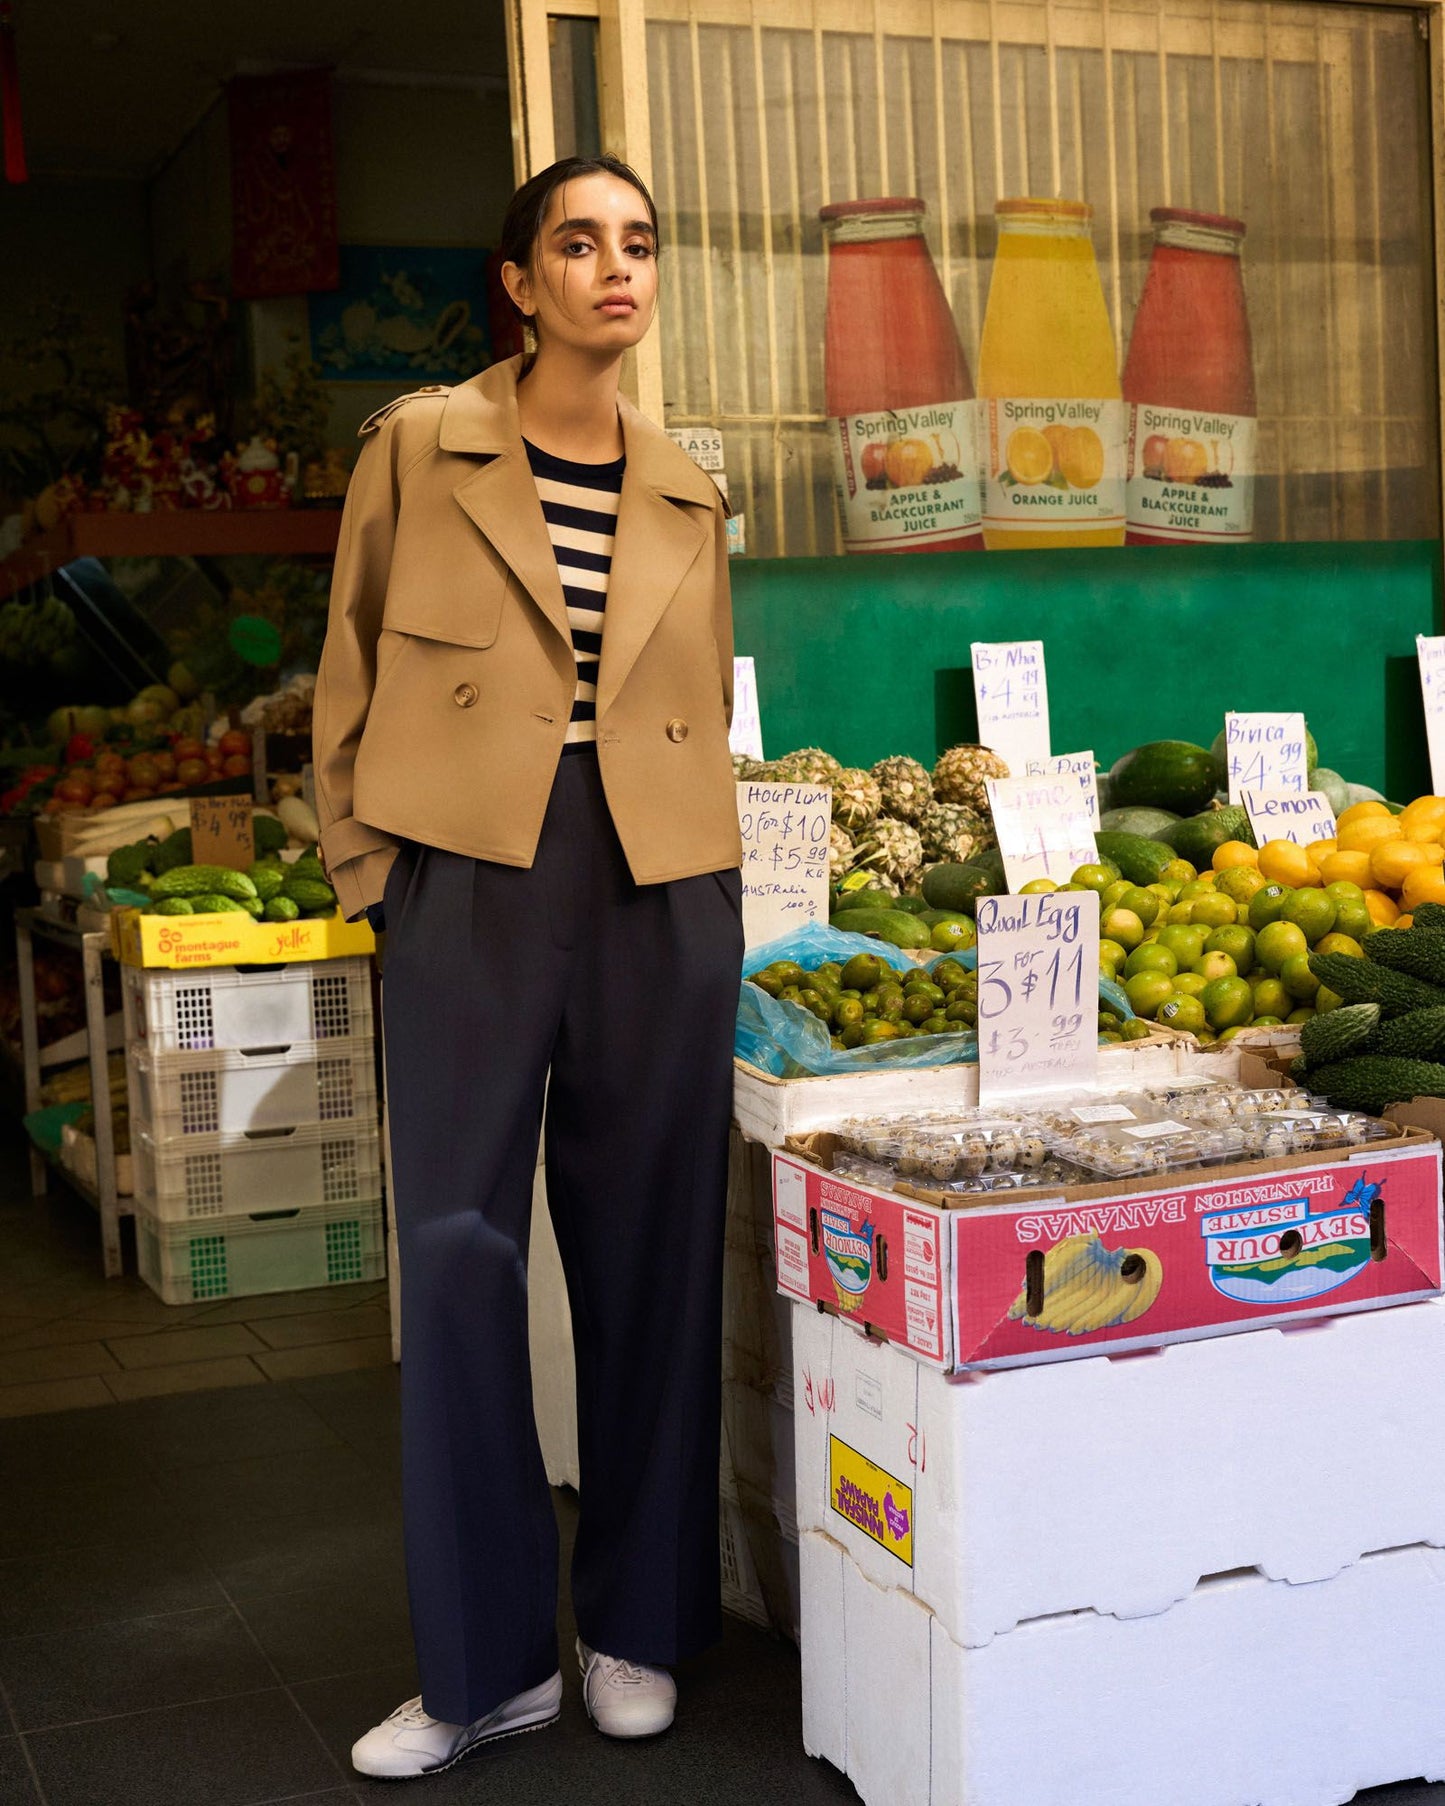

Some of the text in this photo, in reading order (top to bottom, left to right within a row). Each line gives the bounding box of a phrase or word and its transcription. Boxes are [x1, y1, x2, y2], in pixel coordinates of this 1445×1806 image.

[1004, 402, 1101, 422] Spring Valley
[855, 410, 955, 438] Spring Valley
[1143, 410, 1235, 439] Spring Valley
[890, 490, 942, 506] APPLE &
[1012, 494, 1098, 505] ORANGE JUICE
[1161, 487, 1210, 502] APPLE &
[870, 499, 965, 521] BLACKCURRANT
[1141, 497, 1228, 516] BLACKCURRANT
[903, 517, 937, 532] JUICE
[1168, 515, 1200, 527] JUICE
[1247, 792, 1322, 817] Lemon
[1036, 894, 1080, 943] Egg
[175, 940, 240, 955] montague
[175, 952, 212, 964] farms
[979, 959, 1012, 1019] 3
[820, 1180, 873, 1214] BANANAS
[1016, 1174, 1335, 1243] PLANTATION BANANAS
[822, 1214, 848, 1233] ESTATE
[1207, 1204, 1300, 1232] ESTATE
[824, 1231, 869, 1259] SEYMOUR
[839, 1474, 879, 1518] PAPAWS
[835, 1488, 884, 1541] INNISFAIL
